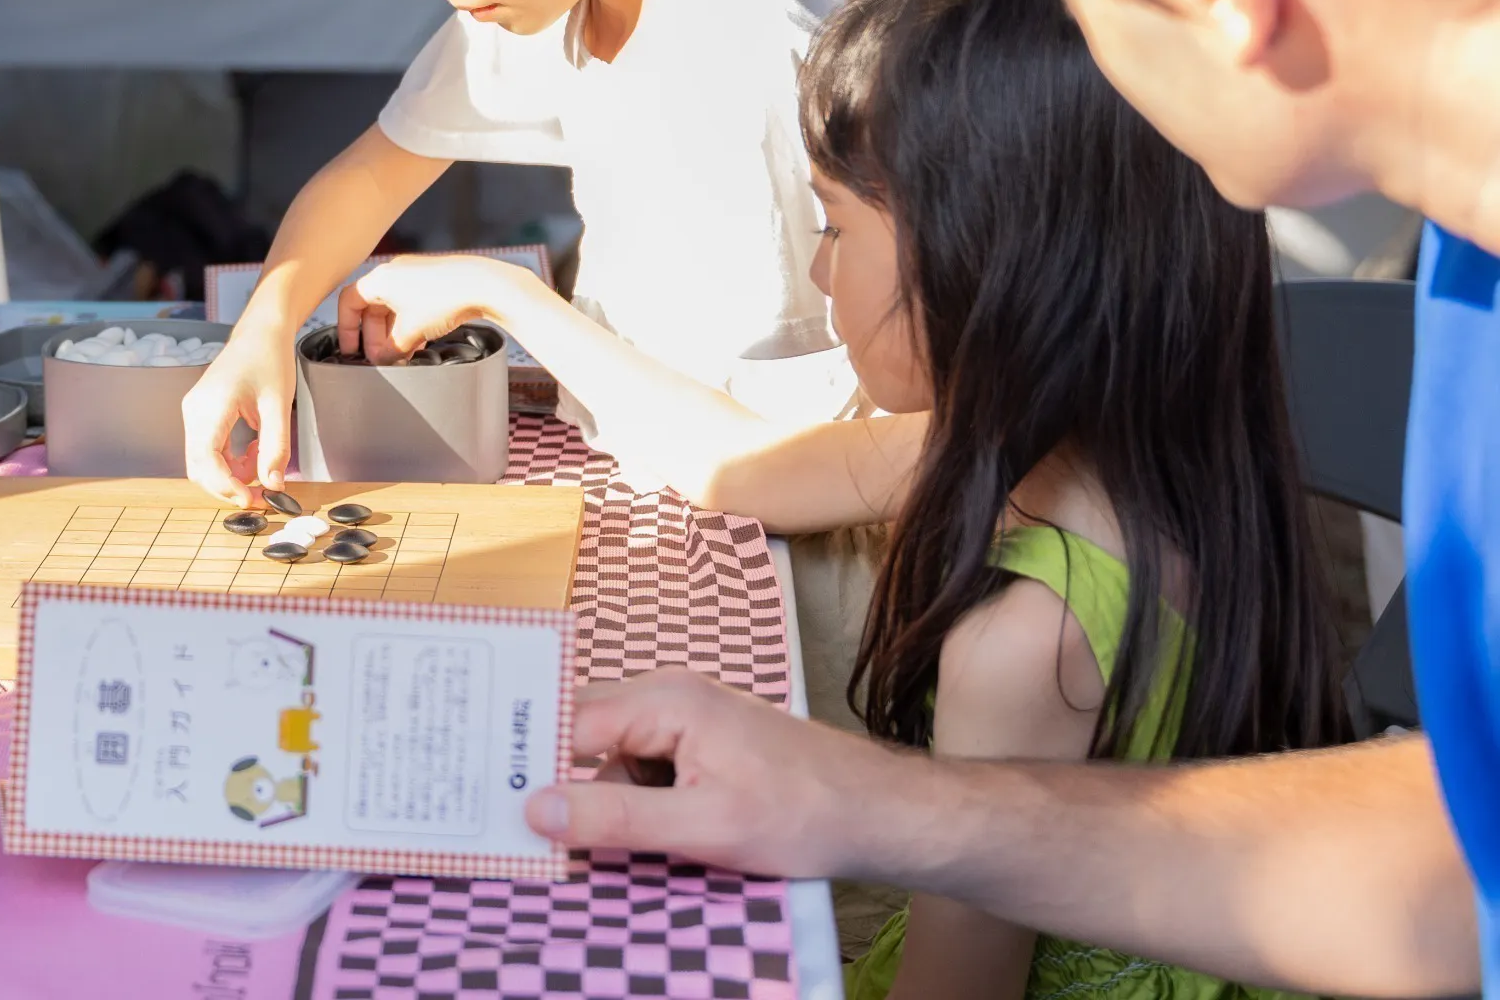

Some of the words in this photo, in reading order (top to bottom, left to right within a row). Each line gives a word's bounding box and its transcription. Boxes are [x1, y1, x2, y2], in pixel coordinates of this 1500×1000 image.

[94, 679, 132, 766] 囲碁
[167, 643, 193, 804] 入門ガイド
